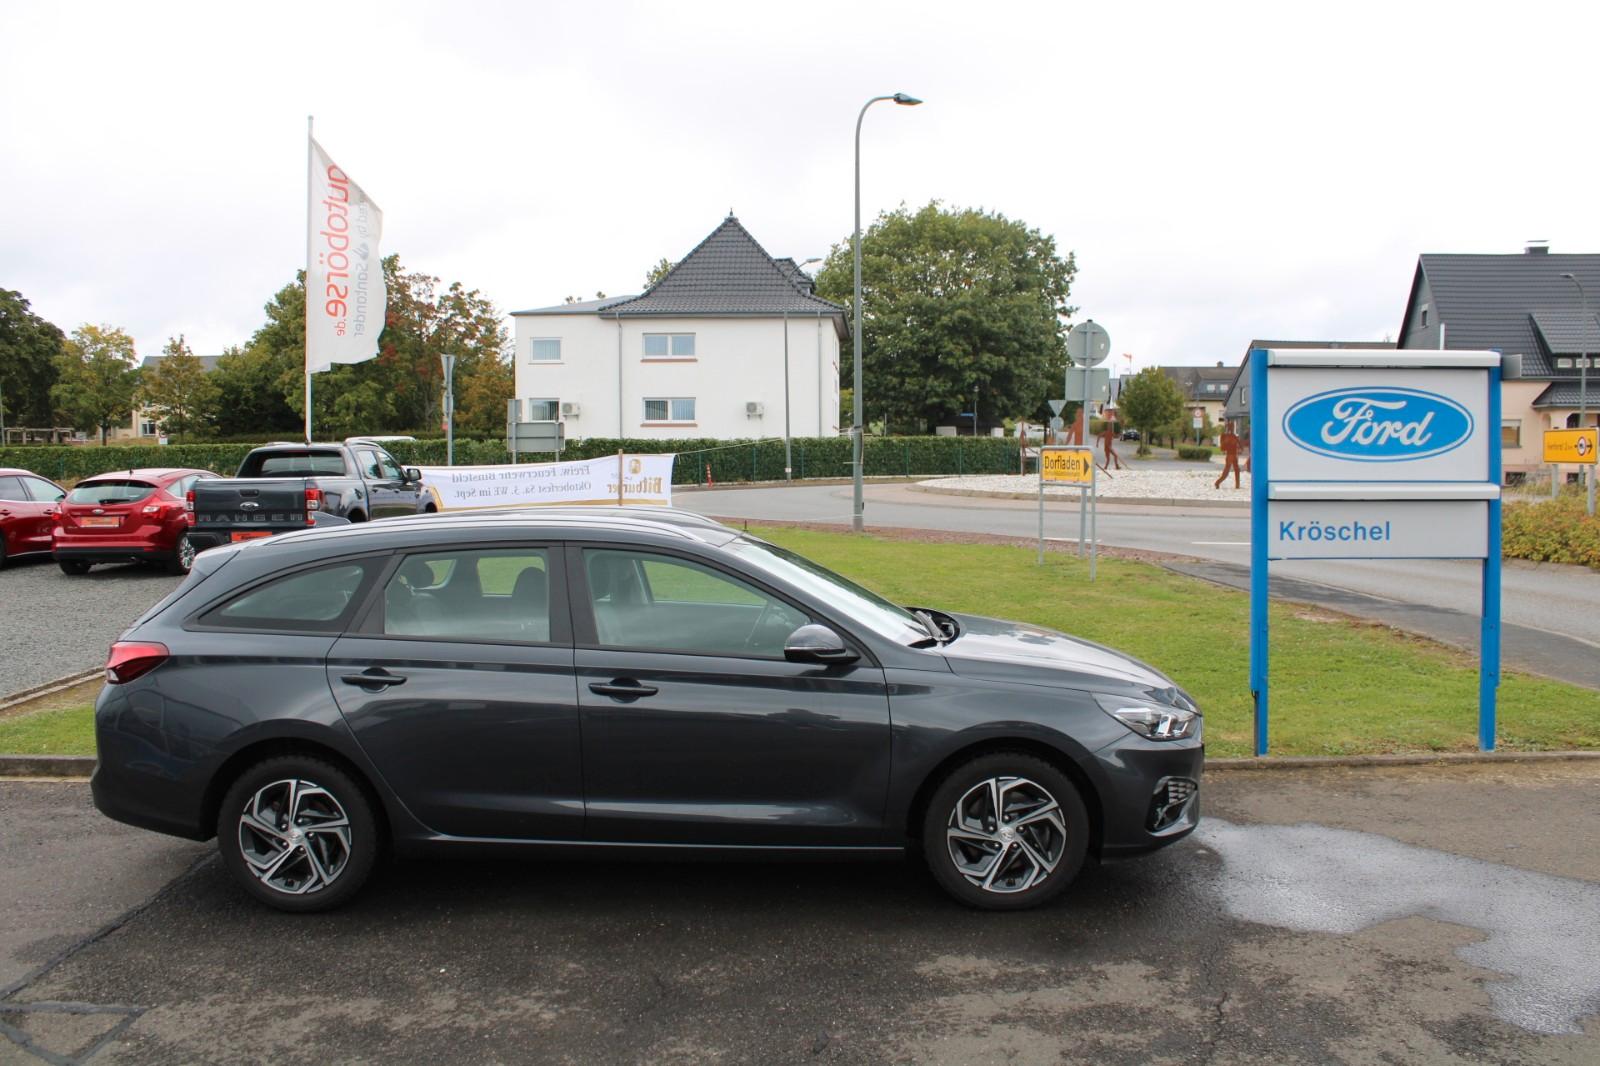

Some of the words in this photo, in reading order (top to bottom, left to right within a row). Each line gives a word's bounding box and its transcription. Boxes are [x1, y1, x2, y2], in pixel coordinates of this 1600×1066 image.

[1320, 397, 1435, 446] Ford
[1044, 455, 1081, 470] Dorfladen
[198, 513, 303, 522] RANGER
[1279, 520, 1391, 541] Kröschel
